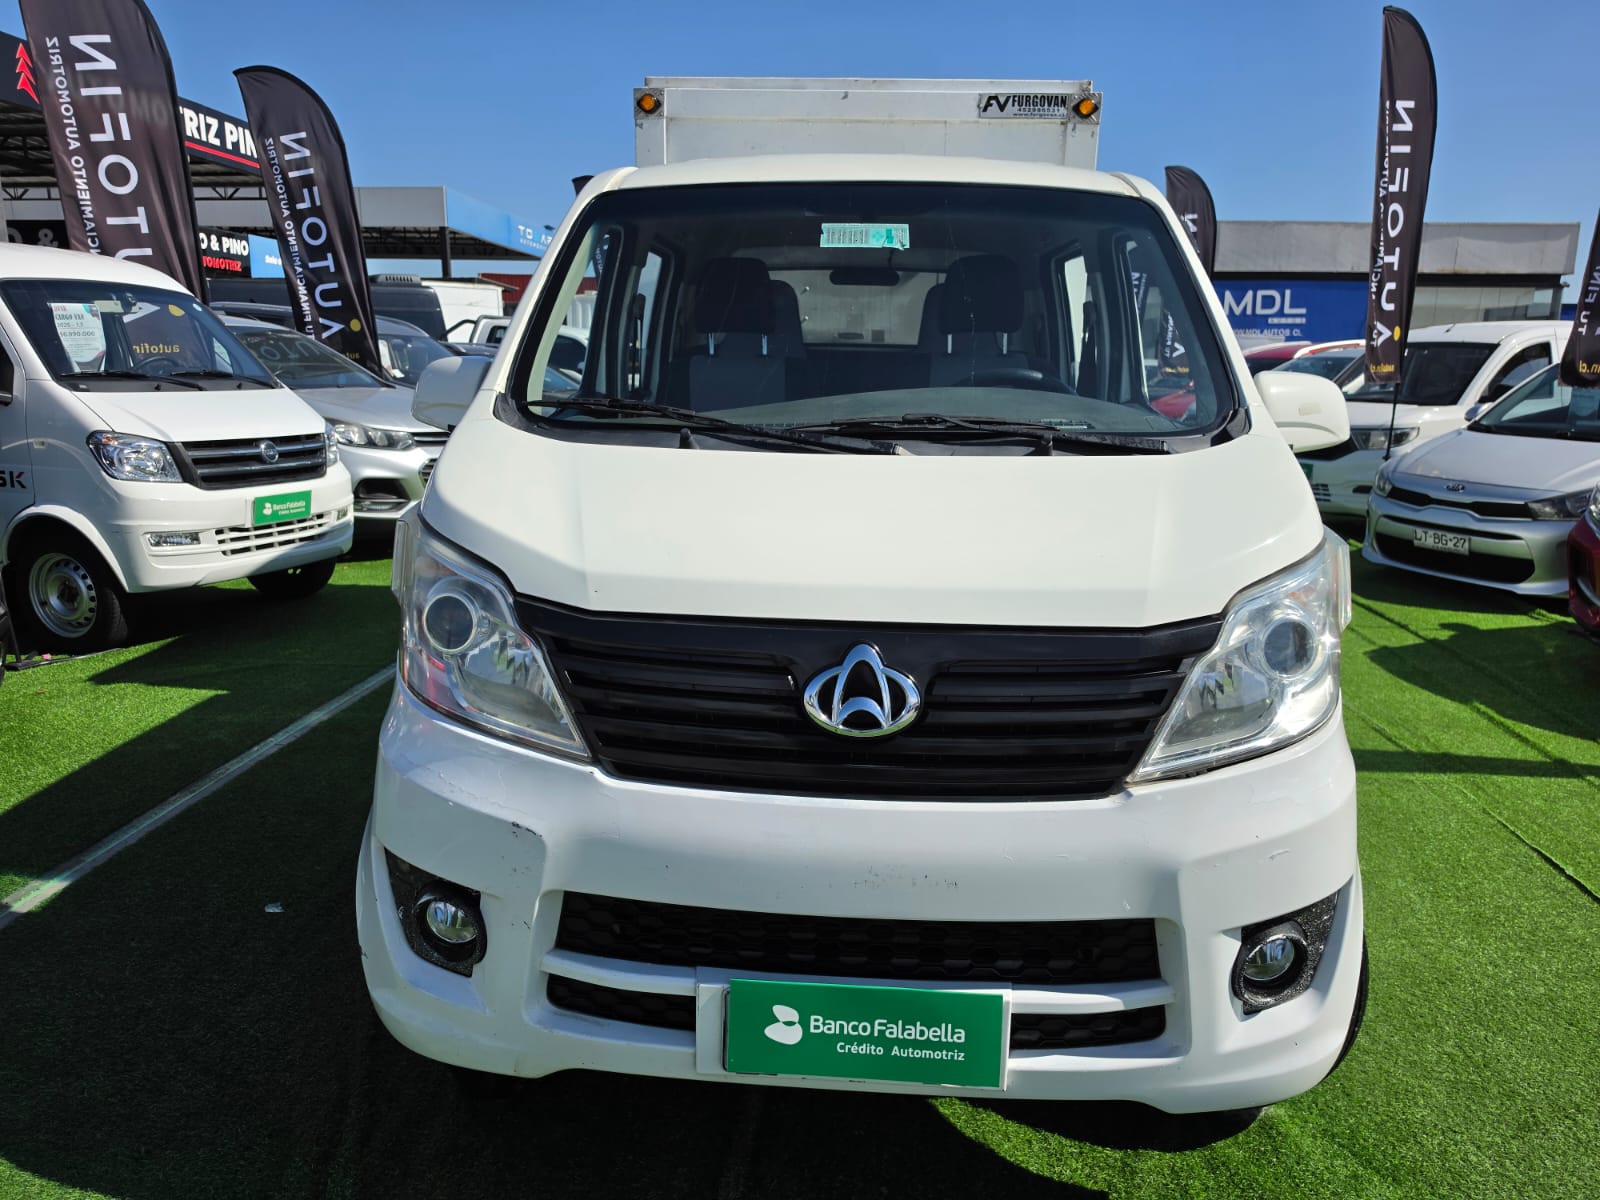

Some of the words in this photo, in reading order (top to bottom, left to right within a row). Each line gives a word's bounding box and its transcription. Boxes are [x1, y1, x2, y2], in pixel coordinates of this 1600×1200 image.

[1011, 95, 1067, 108] FURGOVAN
[221, 236, 249, 256] PINO
[1223, 289, 1307, 316] MDL
[836, 1041, 884, 1056] Crédito
[891, 1045, 965, 1061] Automotriz
